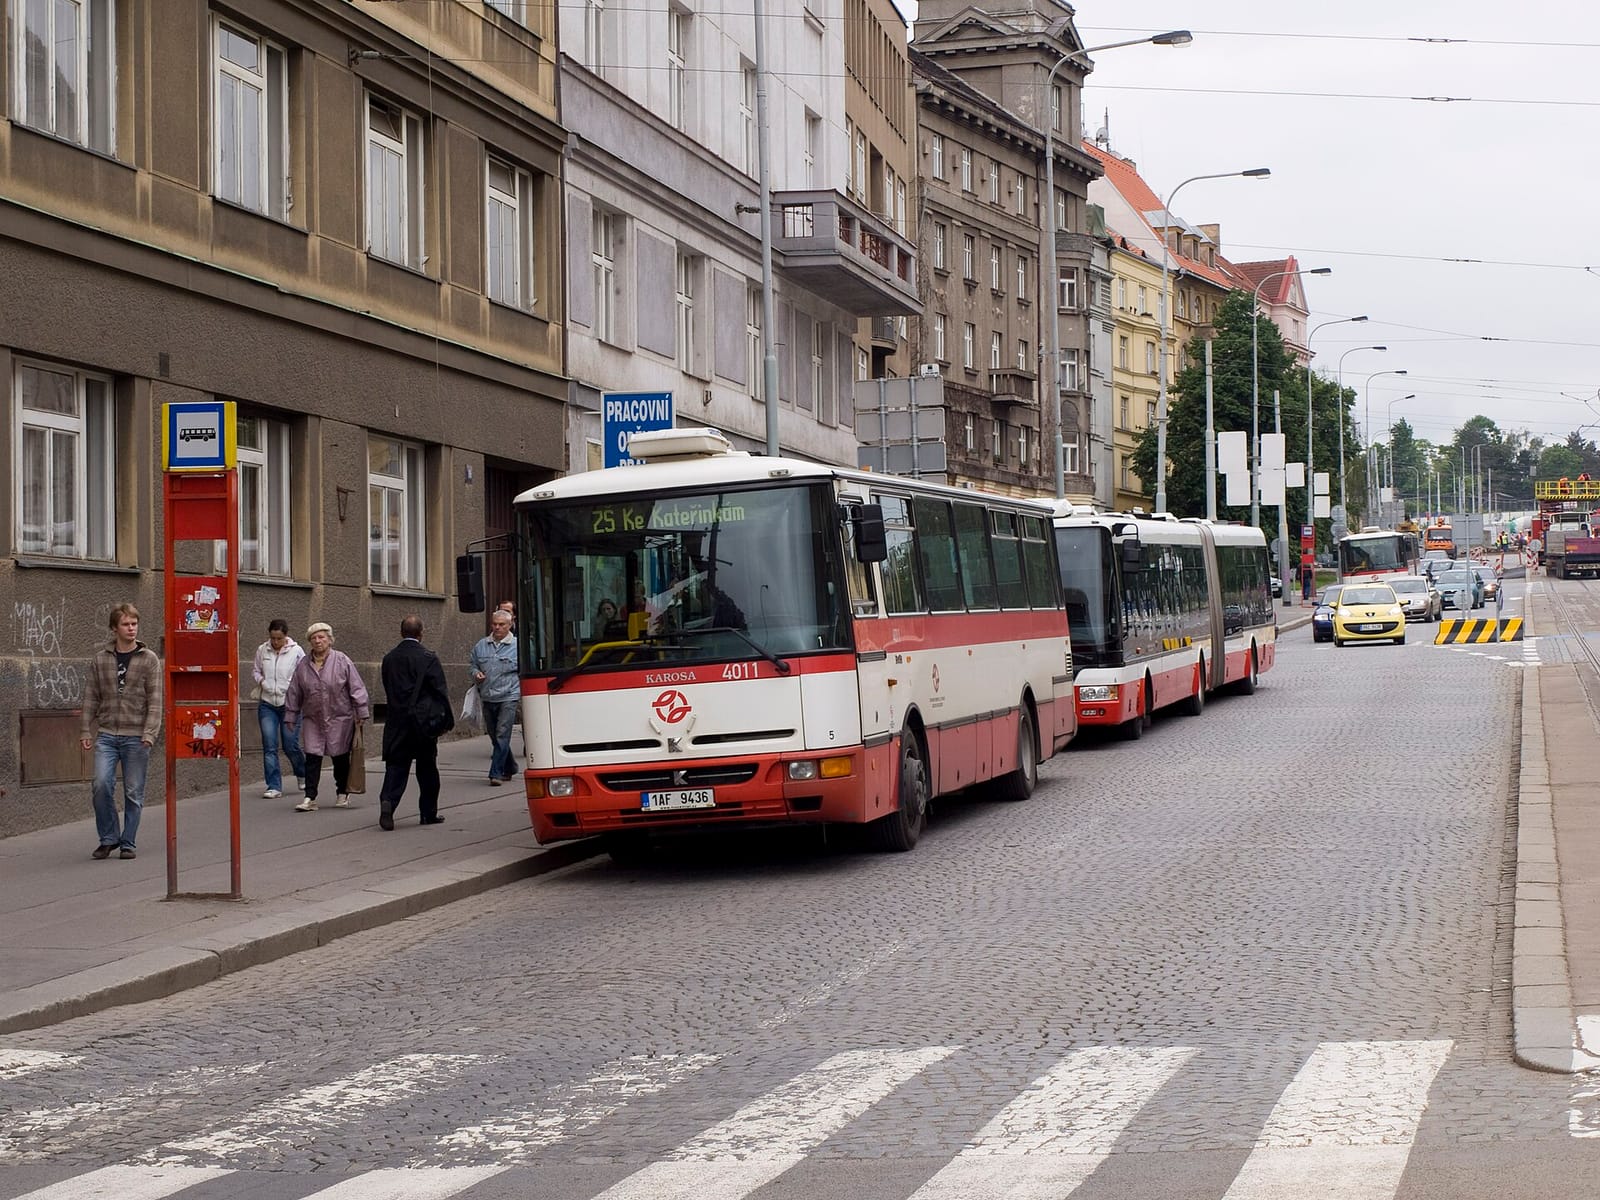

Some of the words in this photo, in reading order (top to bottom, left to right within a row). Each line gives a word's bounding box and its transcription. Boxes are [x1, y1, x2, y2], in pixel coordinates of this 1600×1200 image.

[606, 394, 670, 422] PRACOVNÍ
[623, 507, 646, 531] Ke
[645, 671, 697, 684] KAROSA
[722, 662, 760, 680] 4011
[829, 730, 835, 740] 5
[667, 737, 683, 753] K
[673, 769, 689, 786] K
[651, 793, 672, 806] 1AF
[680, 791, 709, 804] 9436
